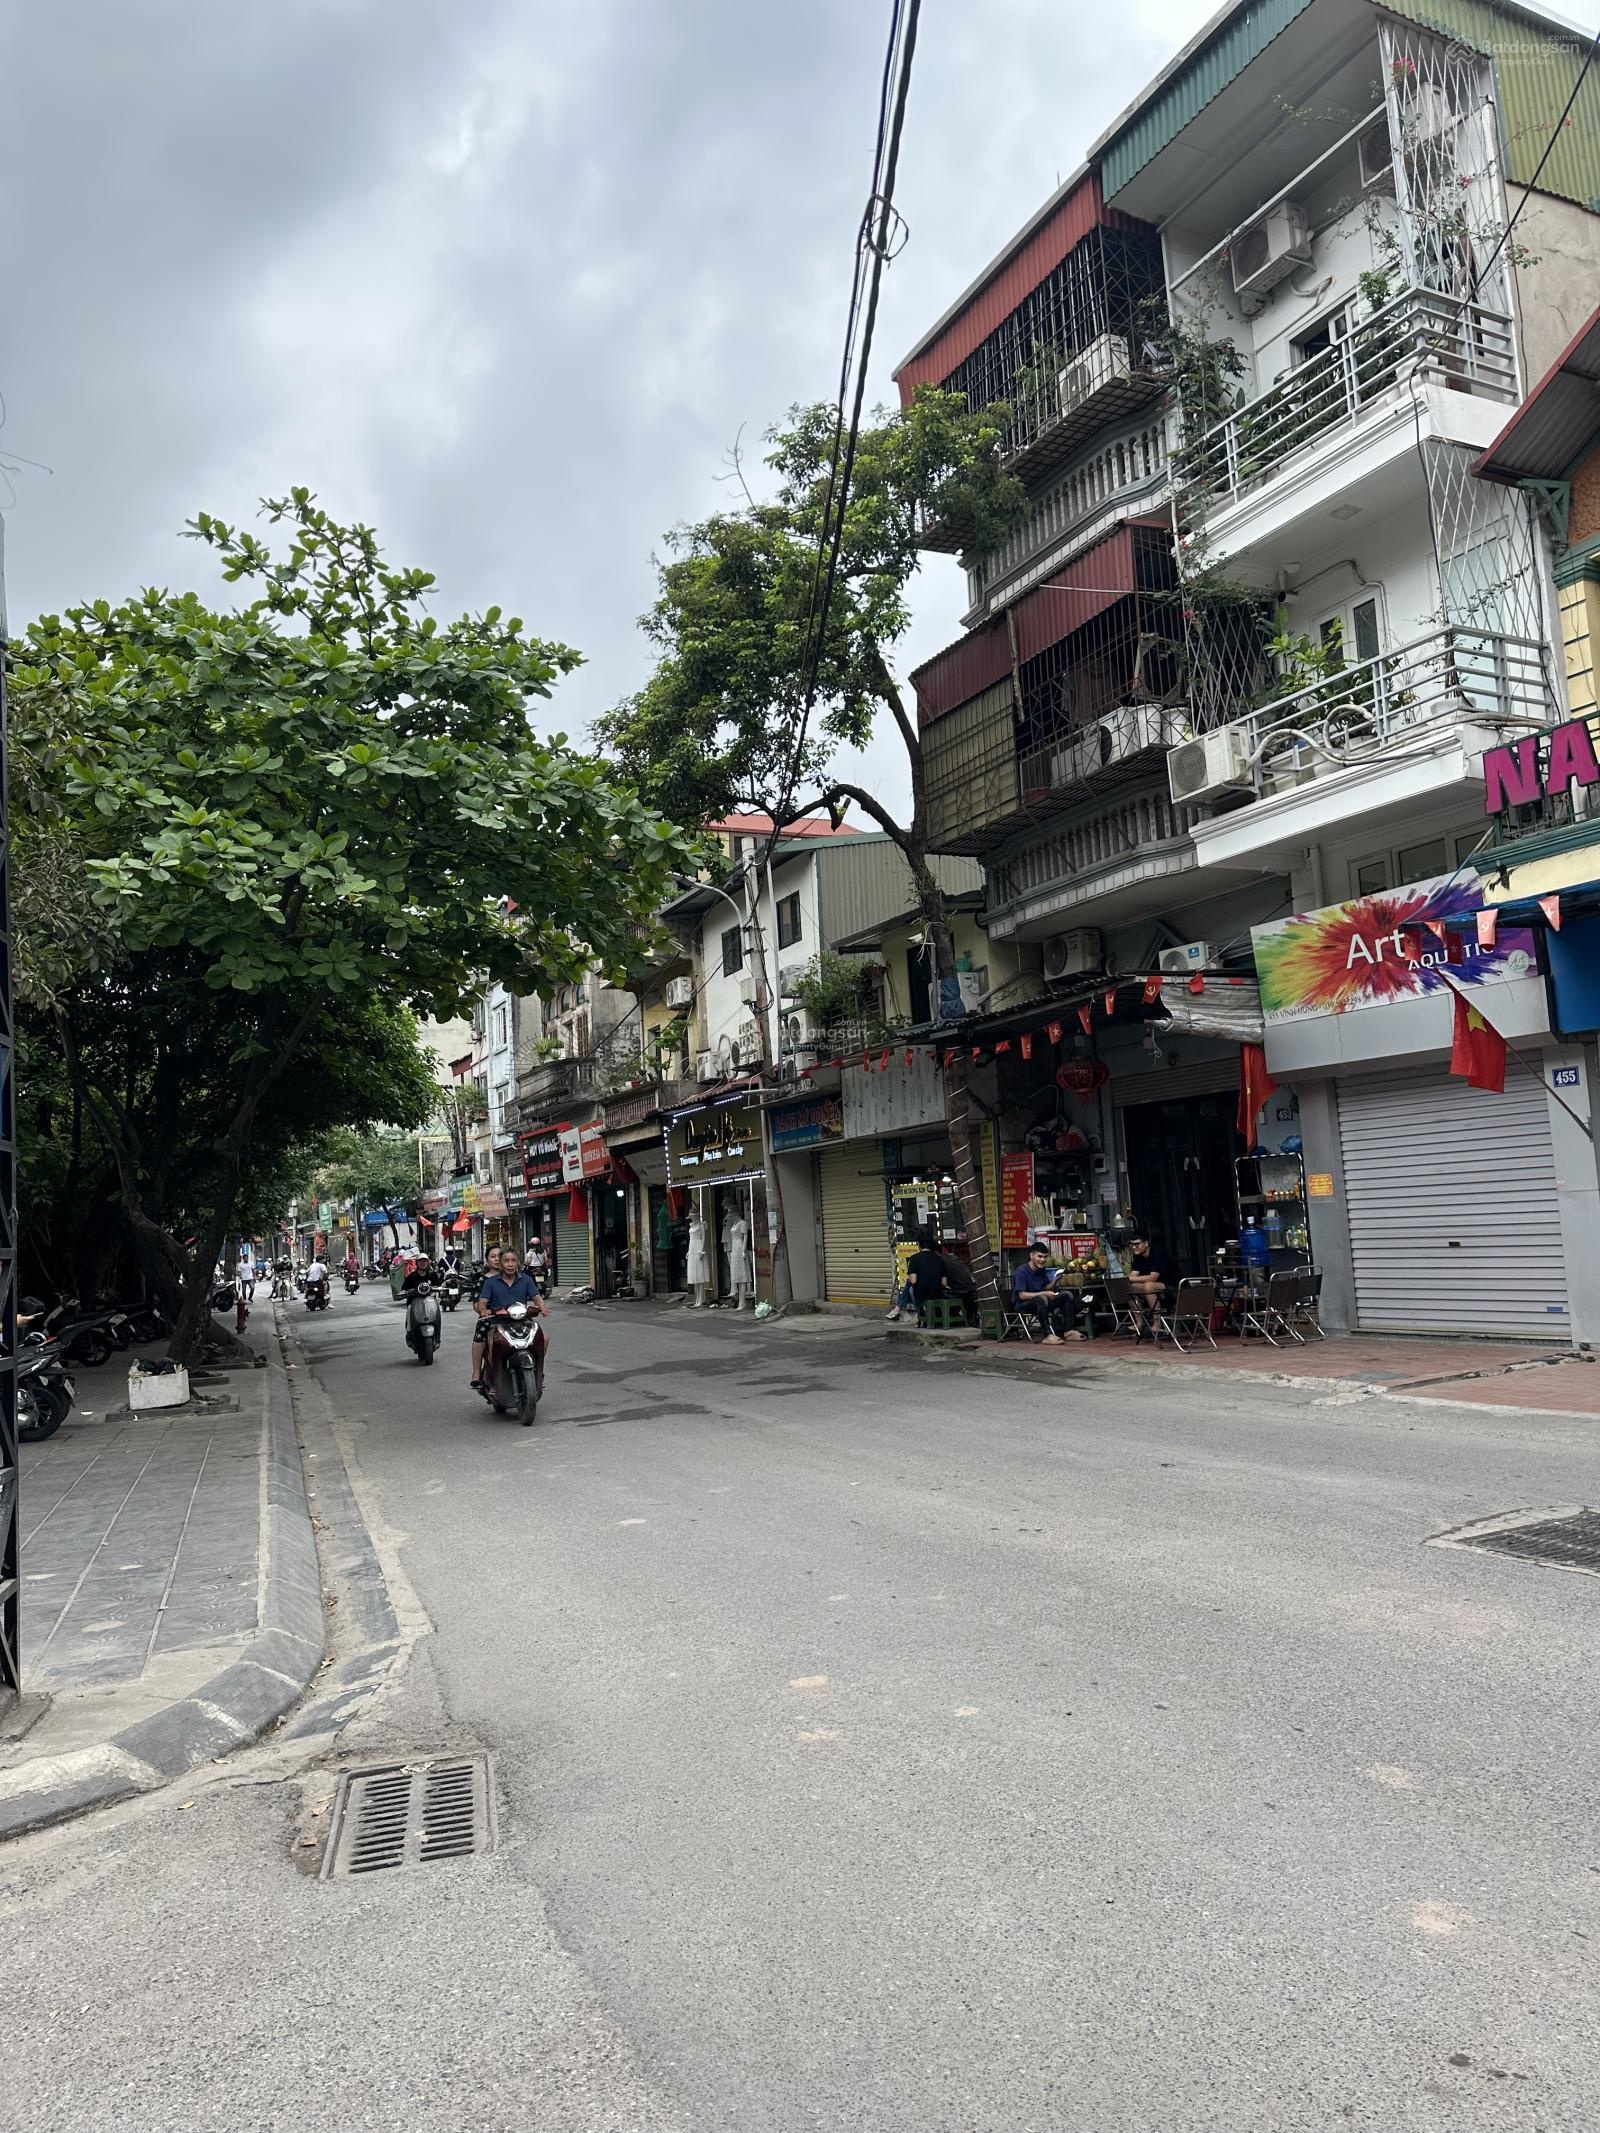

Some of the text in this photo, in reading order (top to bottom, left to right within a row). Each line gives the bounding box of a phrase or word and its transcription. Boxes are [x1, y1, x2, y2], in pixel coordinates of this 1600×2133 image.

[1483, 721, 1600, 814] NA
[1346, 928, 1406, 969] Art
[1408, 942, 1494, 971] AQUTI
[1556, 1070, 1576, 1083] 455
